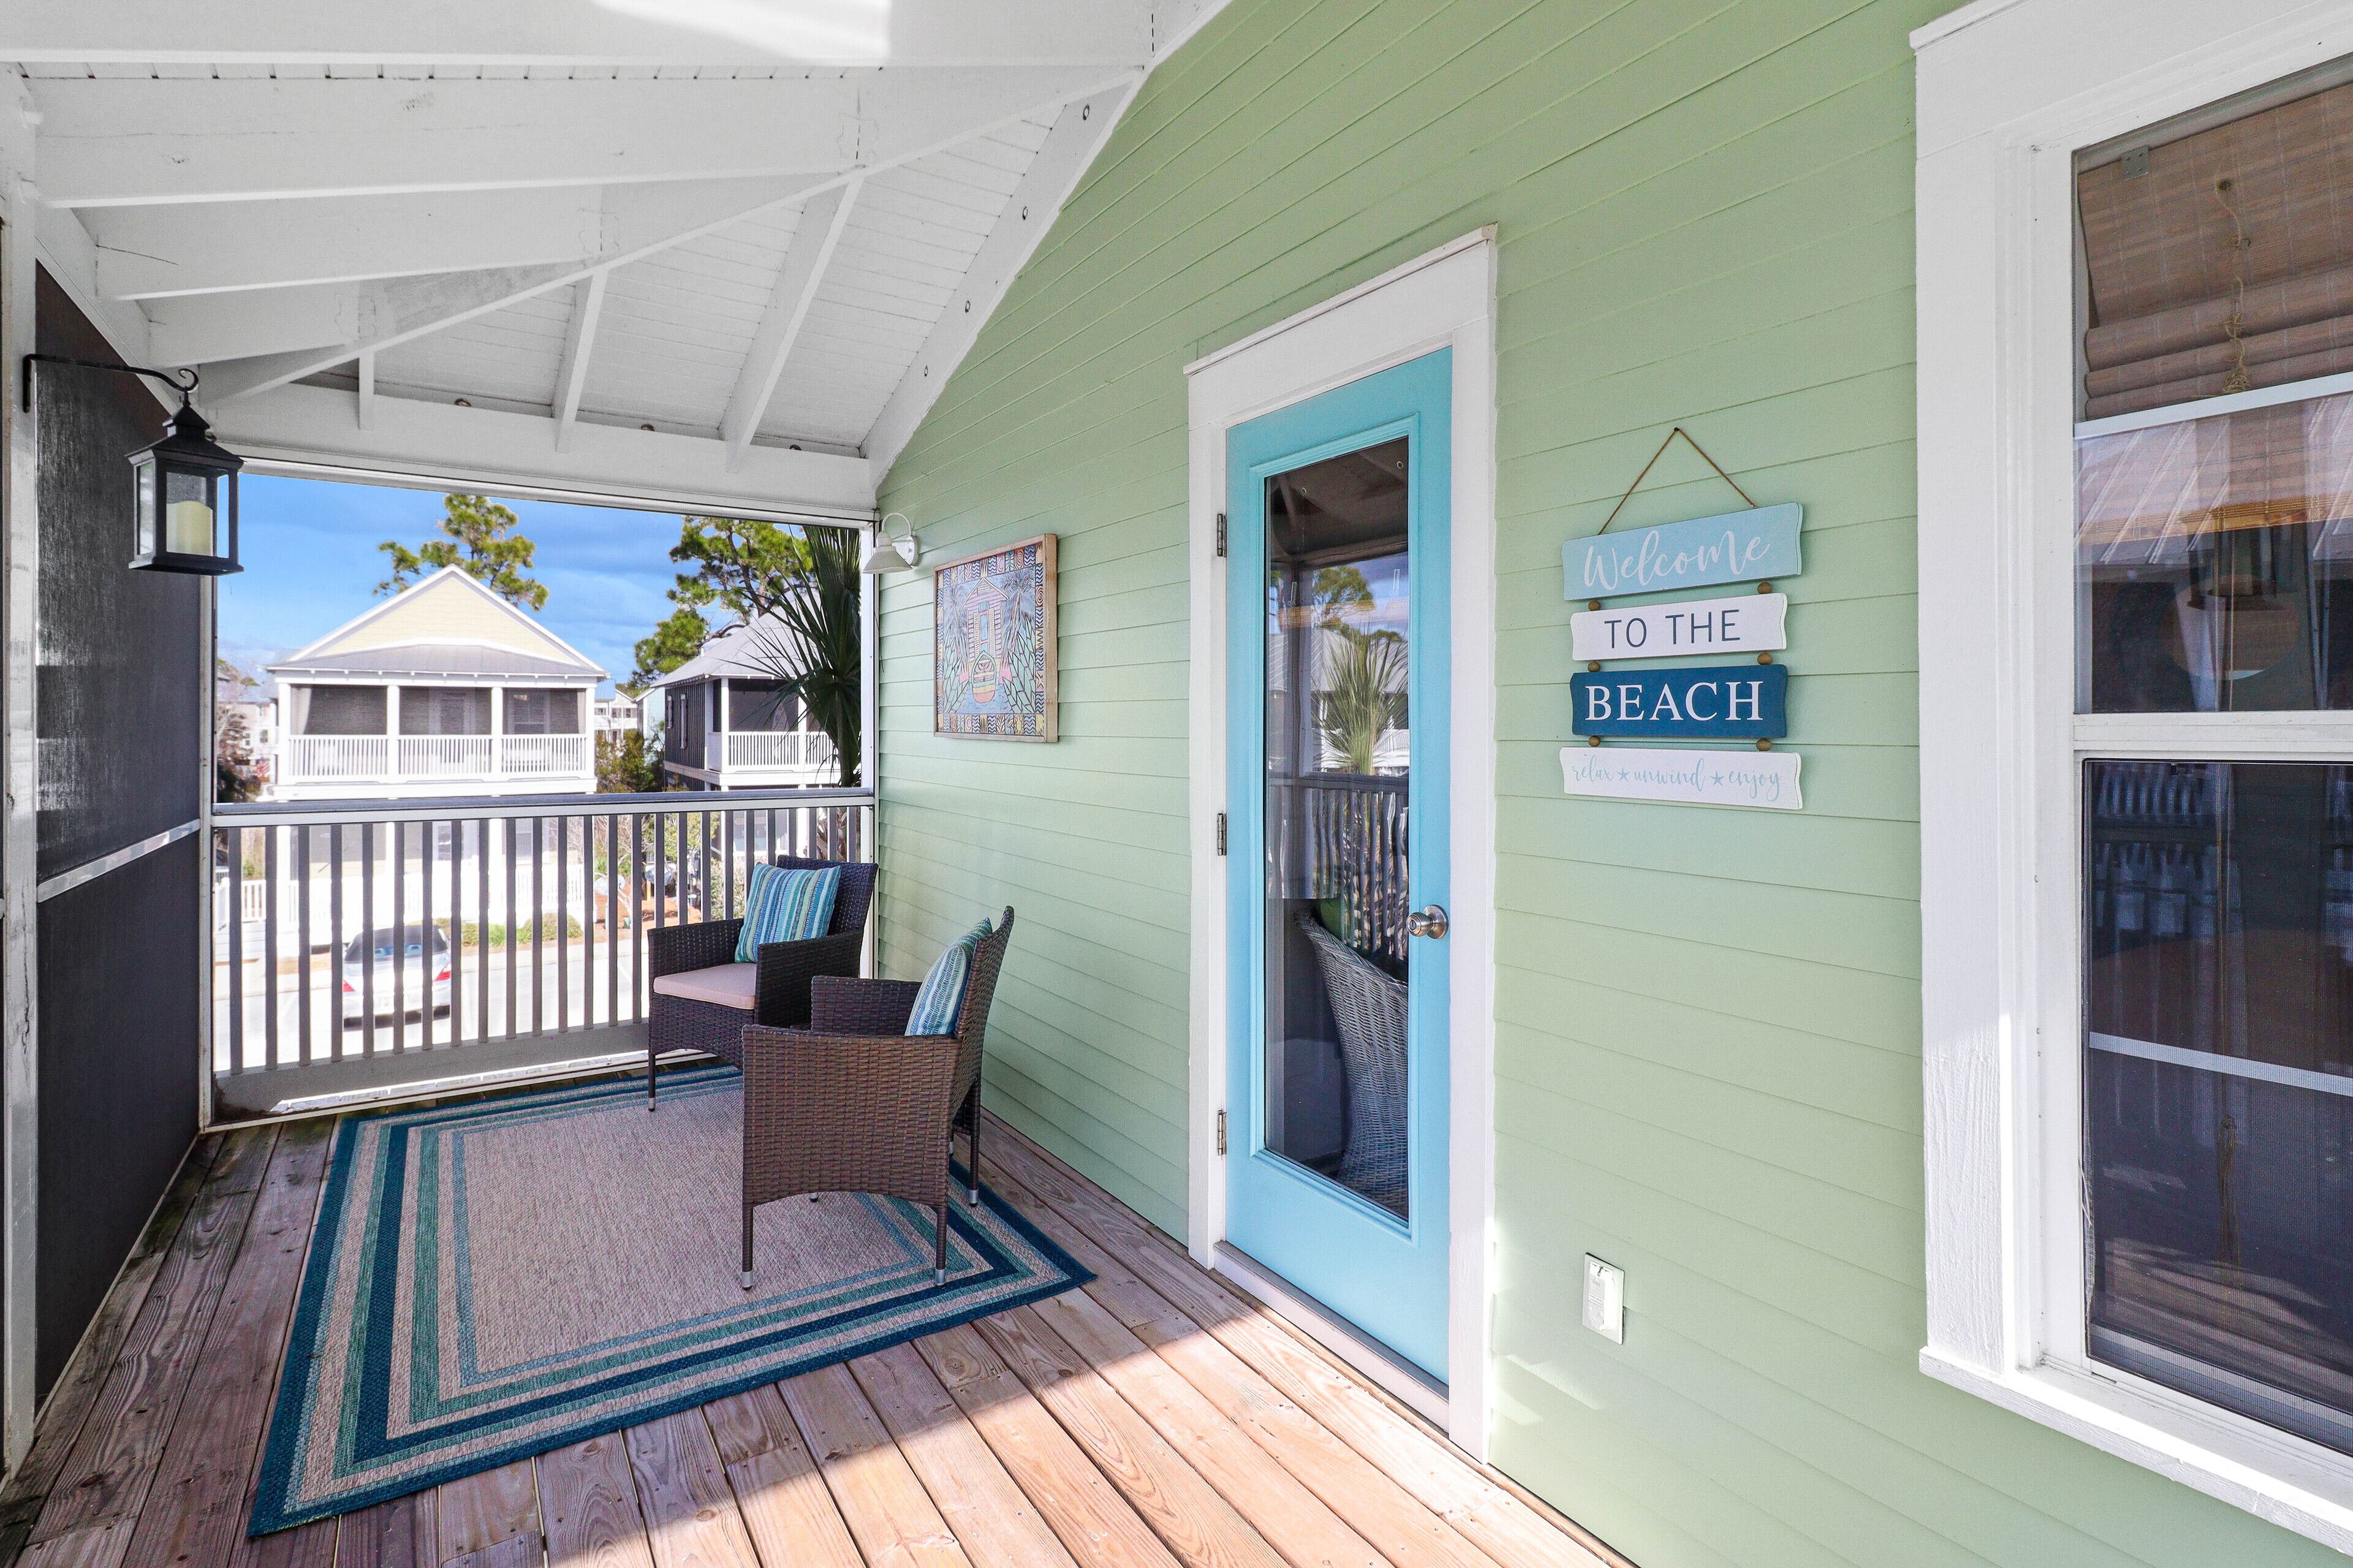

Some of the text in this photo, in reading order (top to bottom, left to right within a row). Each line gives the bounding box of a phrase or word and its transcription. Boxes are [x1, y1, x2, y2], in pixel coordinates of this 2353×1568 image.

[1583, 529, 1770, 591] Welcome
[1604, 609, 1741, 648] TO THE
[1585, 681, 1764, 721] BEACH
[1572, 755, 1782, 802] relax unwind enjoy
